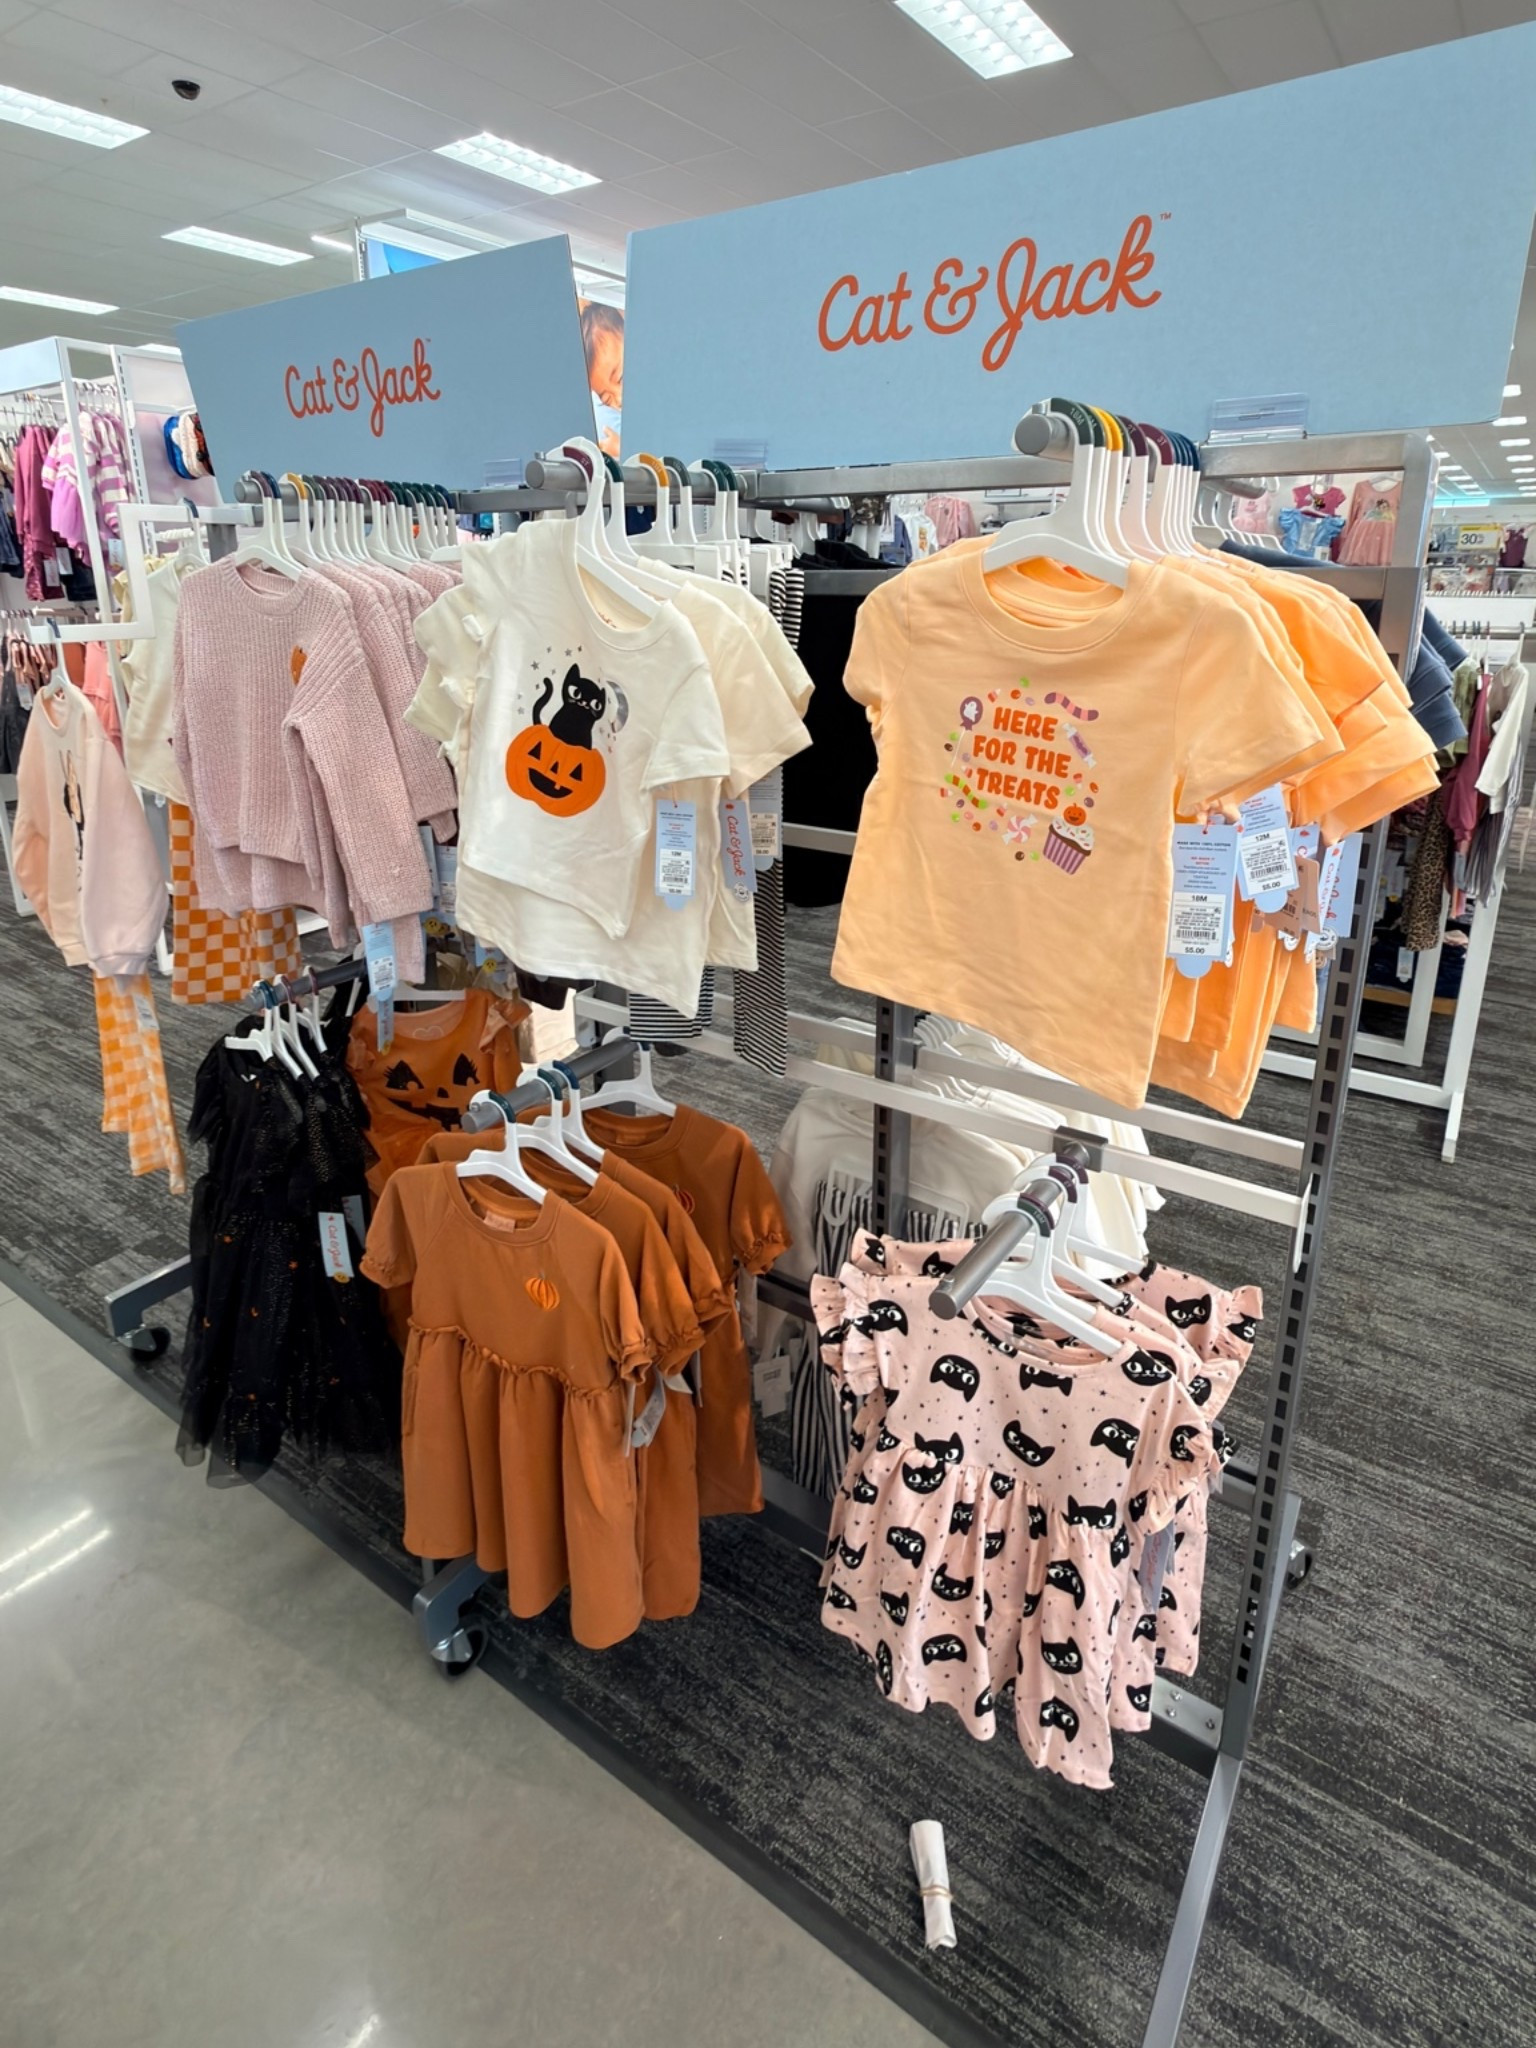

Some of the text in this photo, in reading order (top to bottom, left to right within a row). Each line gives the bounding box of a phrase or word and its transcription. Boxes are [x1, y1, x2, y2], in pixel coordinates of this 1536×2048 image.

[818, 273, 913, 352] Cat
[923, 258, 989, 335] &
[982, 214, 1162, 372] Jack
[284, 337, 442, 438] Cat & Jack
[993, 707, 1059, 741] HERE
[973, 735, 1071, 778] FOR THE
[976, 767, 1060, 809] TREATS
[727, 815, 746, 877] Cat & Jack
[1255, 833, 1270, 842] 12M
[1185, 946, 1205, 954] $5.00
